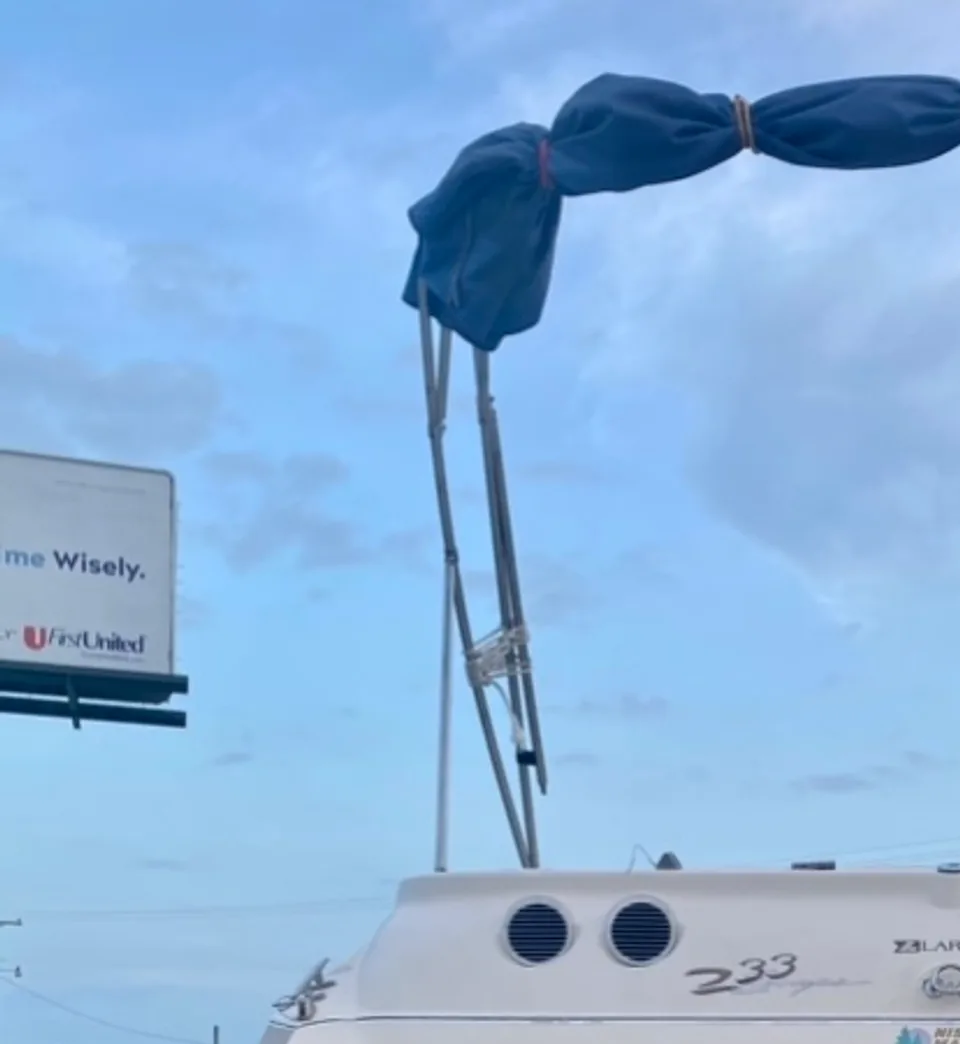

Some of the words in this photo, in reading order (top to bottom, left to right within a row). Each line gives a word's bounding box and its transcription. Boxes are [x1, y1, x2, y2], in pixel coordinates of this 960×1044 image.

[0, 544, 45, 568] me
[53, 549, 145, 583] Wisely.
[684, 952, 798, 996] 233
